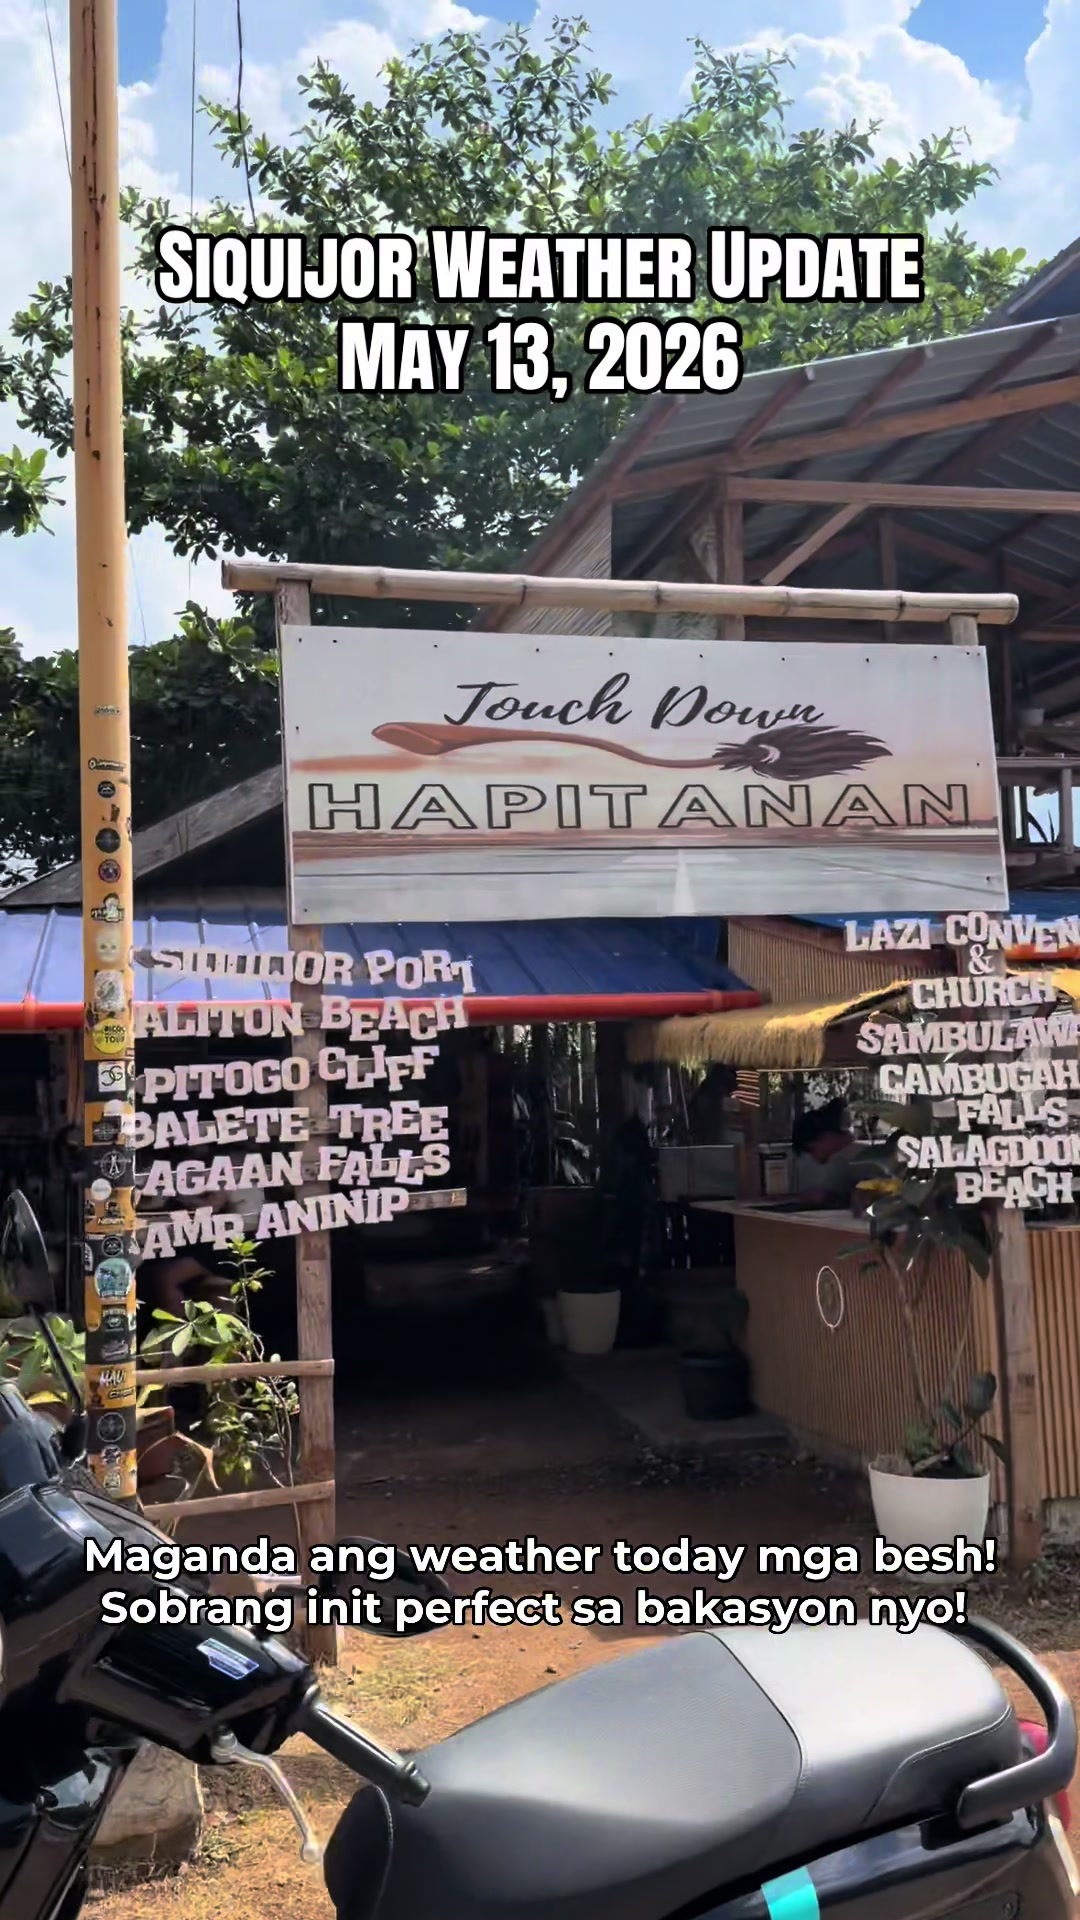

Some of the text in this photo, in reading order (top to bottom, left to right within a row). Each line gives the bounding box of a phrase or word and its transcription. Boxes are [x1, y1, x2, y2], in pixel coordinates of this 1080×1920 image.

[444, 672, 824, 730] Touch Down
[308, 783, 970, 831] HAPITANAN
[845, 918, 932, 952] LAZI
[364, 949, 476, 994] PORT
[968, 943, 995, 975] &
[912, 971, 1057, 1010] CHURCH
[133, 995, 468, 1042] ALITON BEACH
[856, 1011, 1080, 1054] SAMBULAW
[142, 1045, 440, 1104] PITOGO CLIFF
[133, 1101, 449, 1150] BALETE TREE
[957, 1091, 1069, 1131] FALLS
[141, 1143, 451, 1198] AGAAN FALLS
[955, 1166, 1074, 1209] BEACH
[255, 1187, 410, 1241] ANINIP
